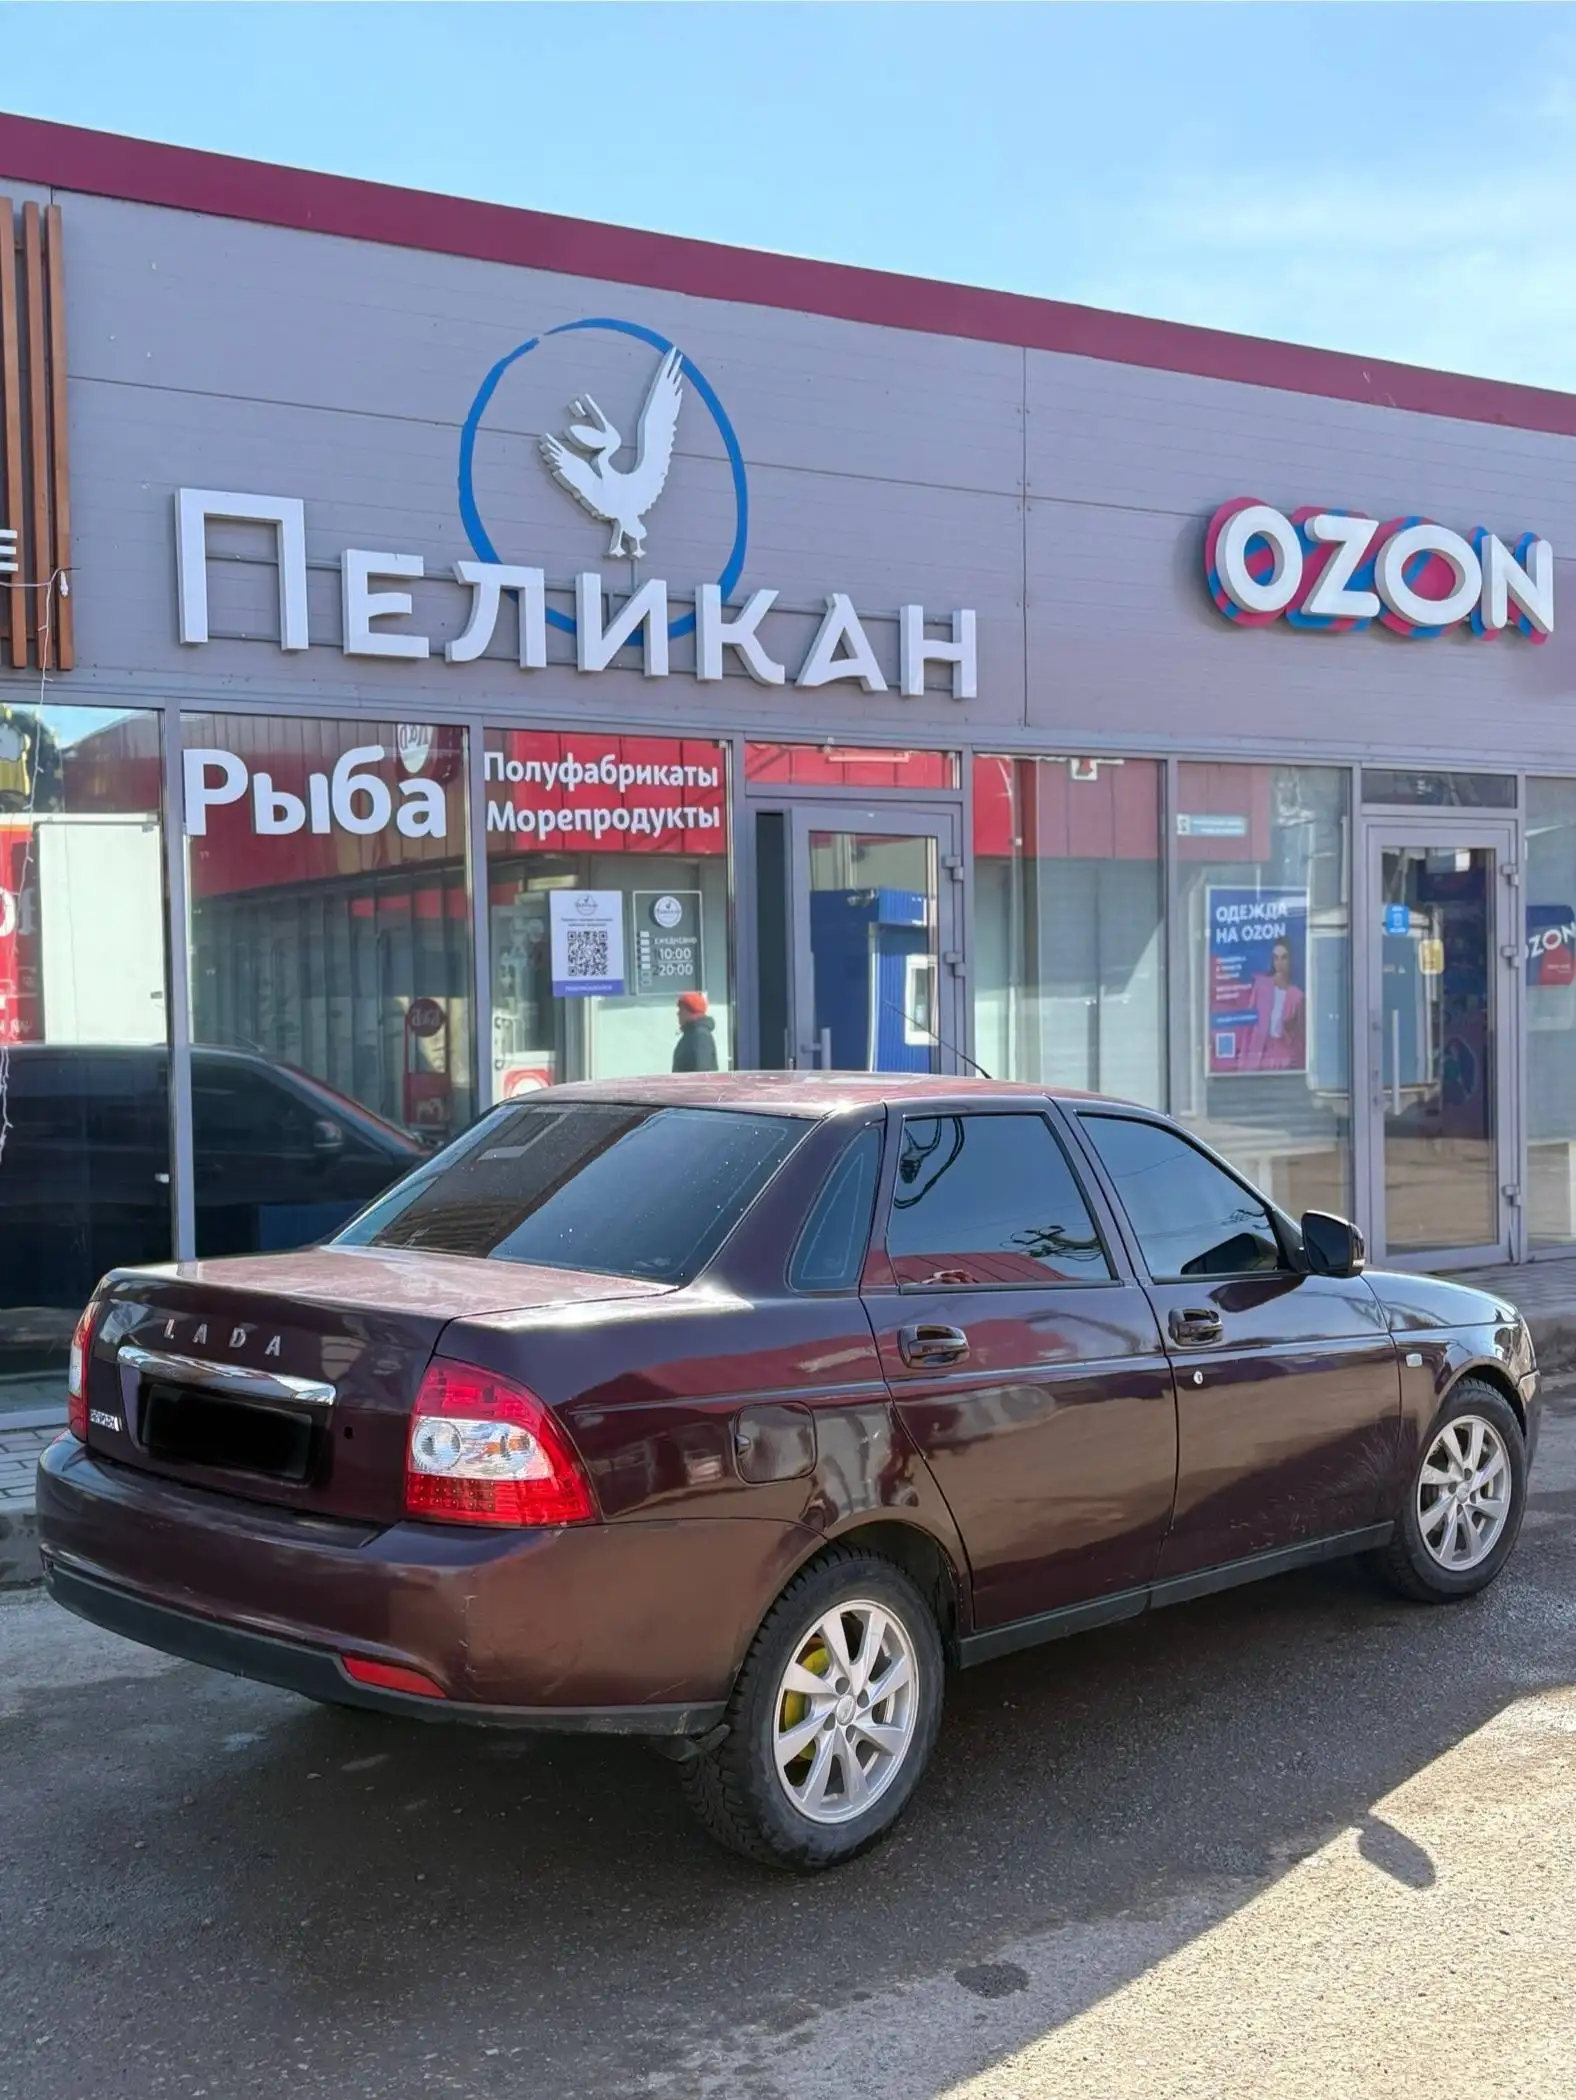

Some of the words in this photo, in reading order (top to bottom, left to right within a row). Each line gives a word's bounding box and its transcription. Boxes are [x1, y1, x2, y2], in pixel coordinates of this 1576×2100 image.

[1214, 503, 1555, 634] OZON
[483, 751, 719, 792] Полуфабрикаты
[183, 744, 447, 839] Рыба
[485, 799, 721, 836] Морепродукты
[1216, 902, 1288, 924] ОДЕЖДА
[1216, 926, 1239, 944] НА
[1241, 923, 1286, 942] OZON
[1524, 921, 1576, 960] ZON
[658, 947, 692, 961] 10:00
[658, 963, 694, 977] 20:00
[163, 1319, 282, 1356] LADA
